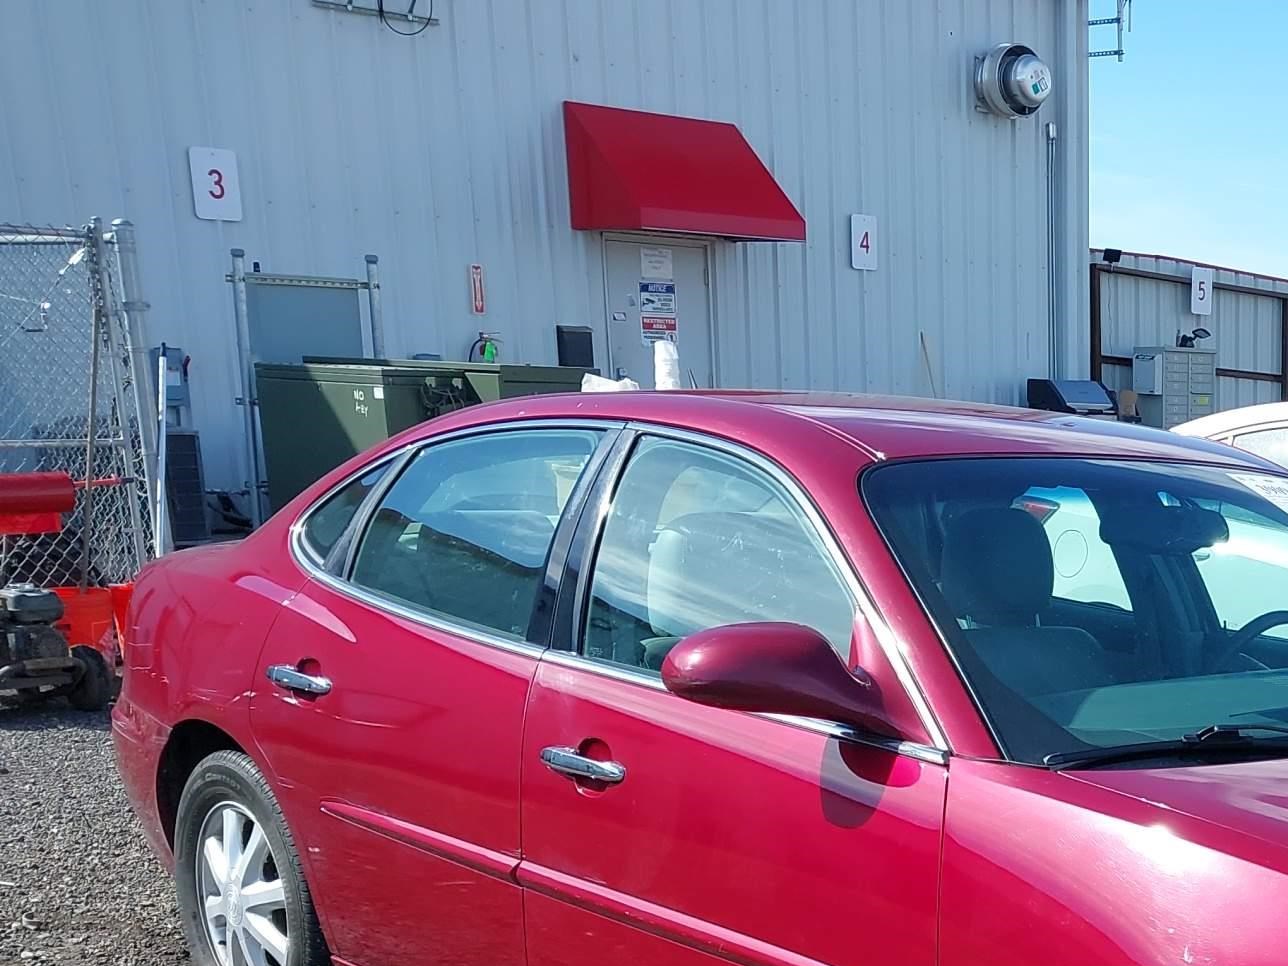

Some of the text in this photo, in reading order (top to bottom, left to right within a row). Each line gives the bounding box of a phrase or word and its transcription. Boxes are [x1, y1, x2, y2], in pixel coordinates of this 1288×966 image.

[207, 169, 225, 200] 3
[859, 231, 870, 255] 4
[1198, 281, 1206, 301] 5
